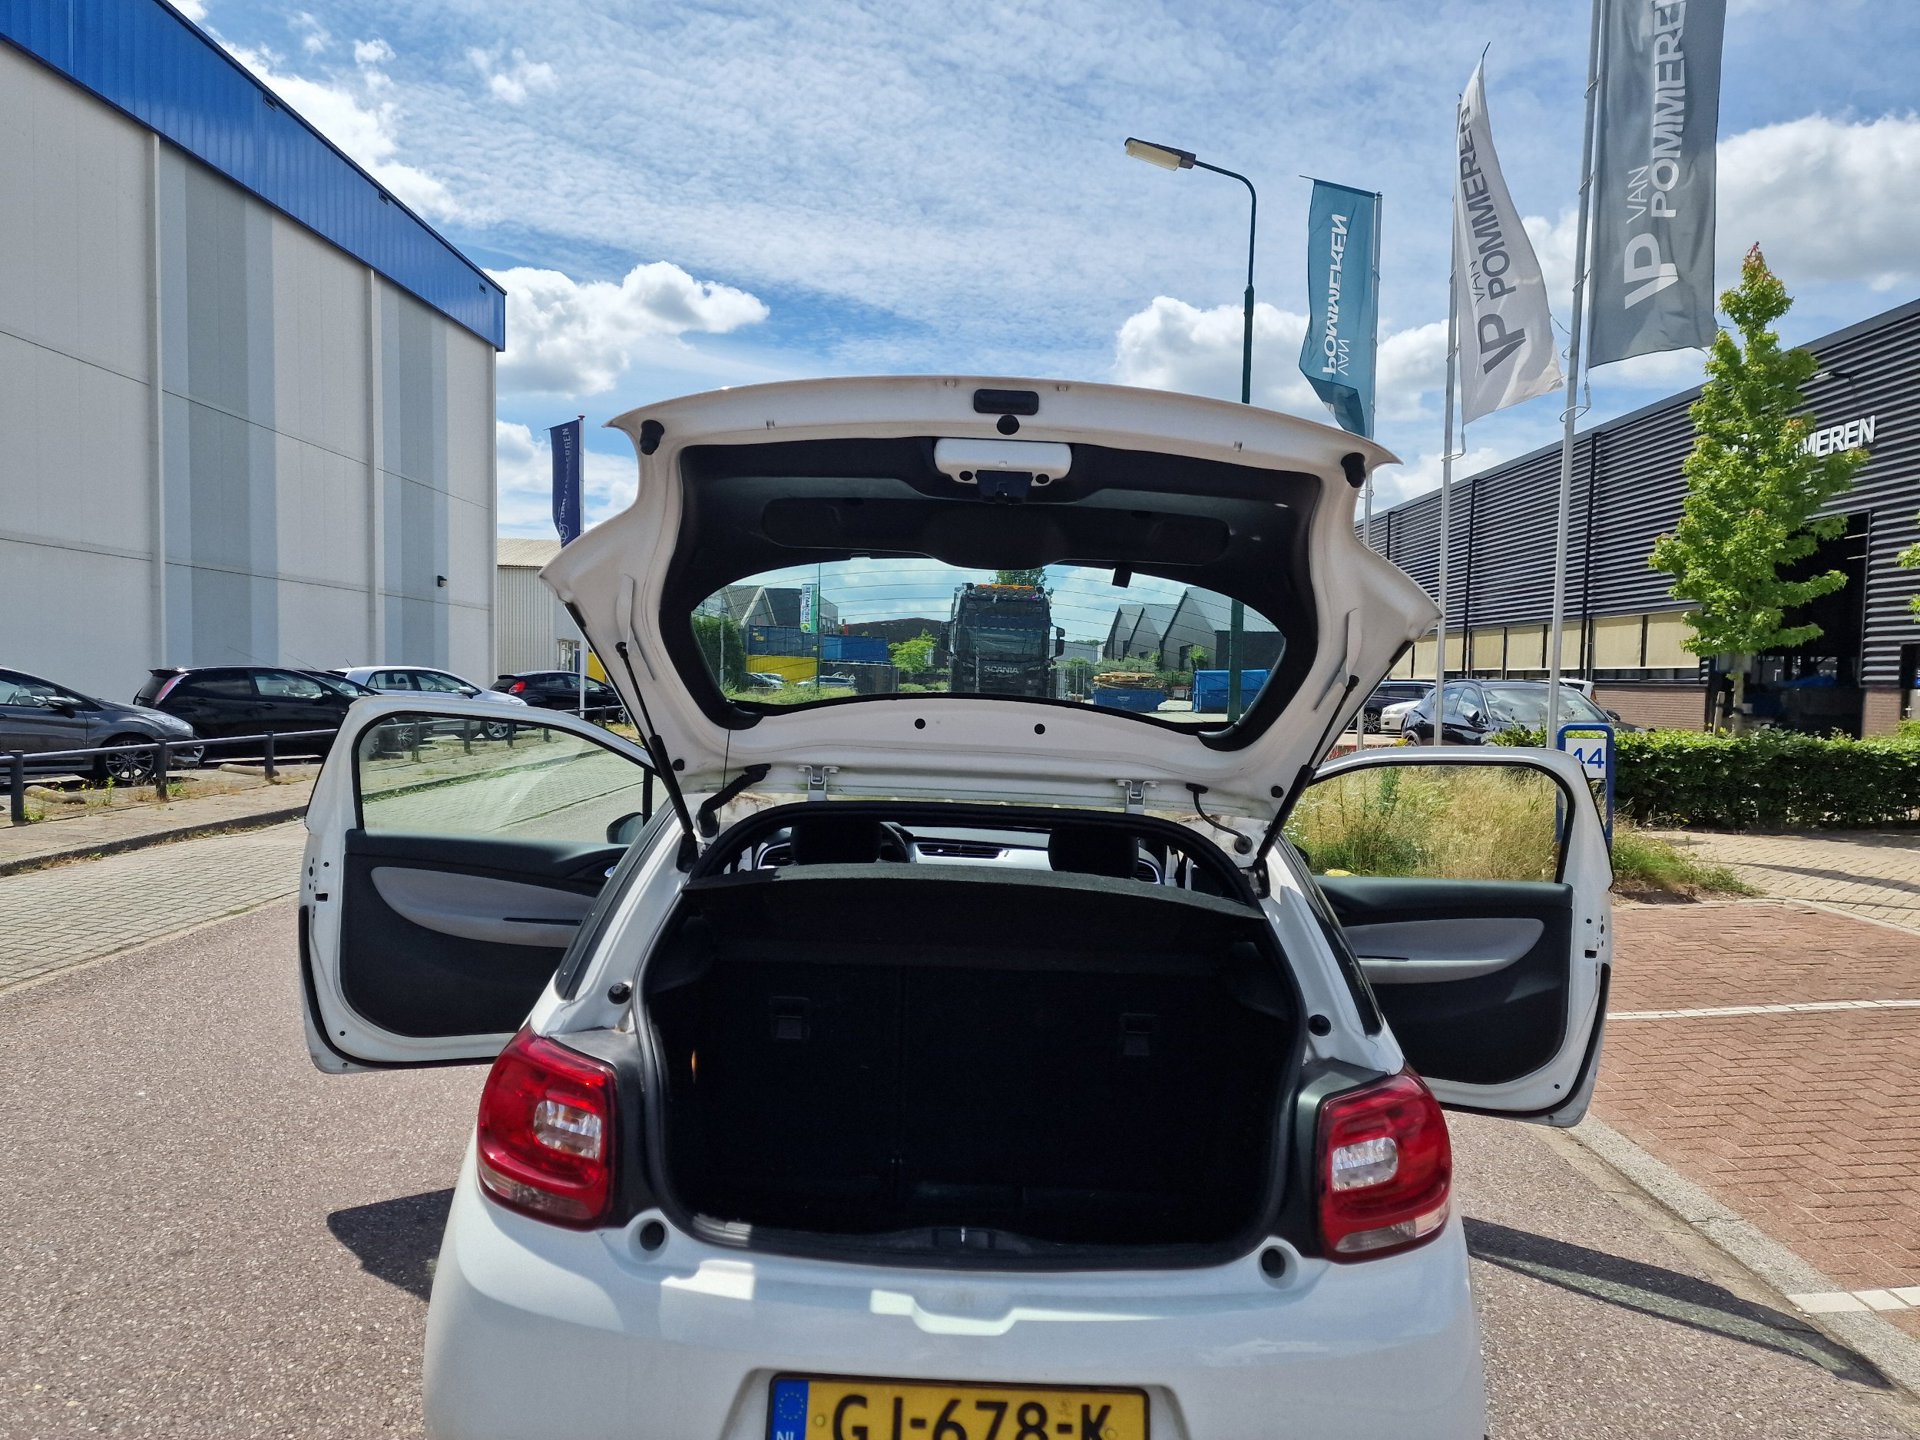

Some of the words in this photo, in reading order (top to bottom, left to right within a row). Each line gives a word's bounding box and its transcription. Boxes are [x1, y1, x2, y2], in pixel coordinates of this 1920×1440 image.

[1651, 0, 1687, 218] POMMERE
[1626, 165, 1649, 224] VAN
[1469, 260, 1485, 307] VAN
[1795, 415, 1876, 457] MEREN
[984, 665, 1019, 674] SCANIA
